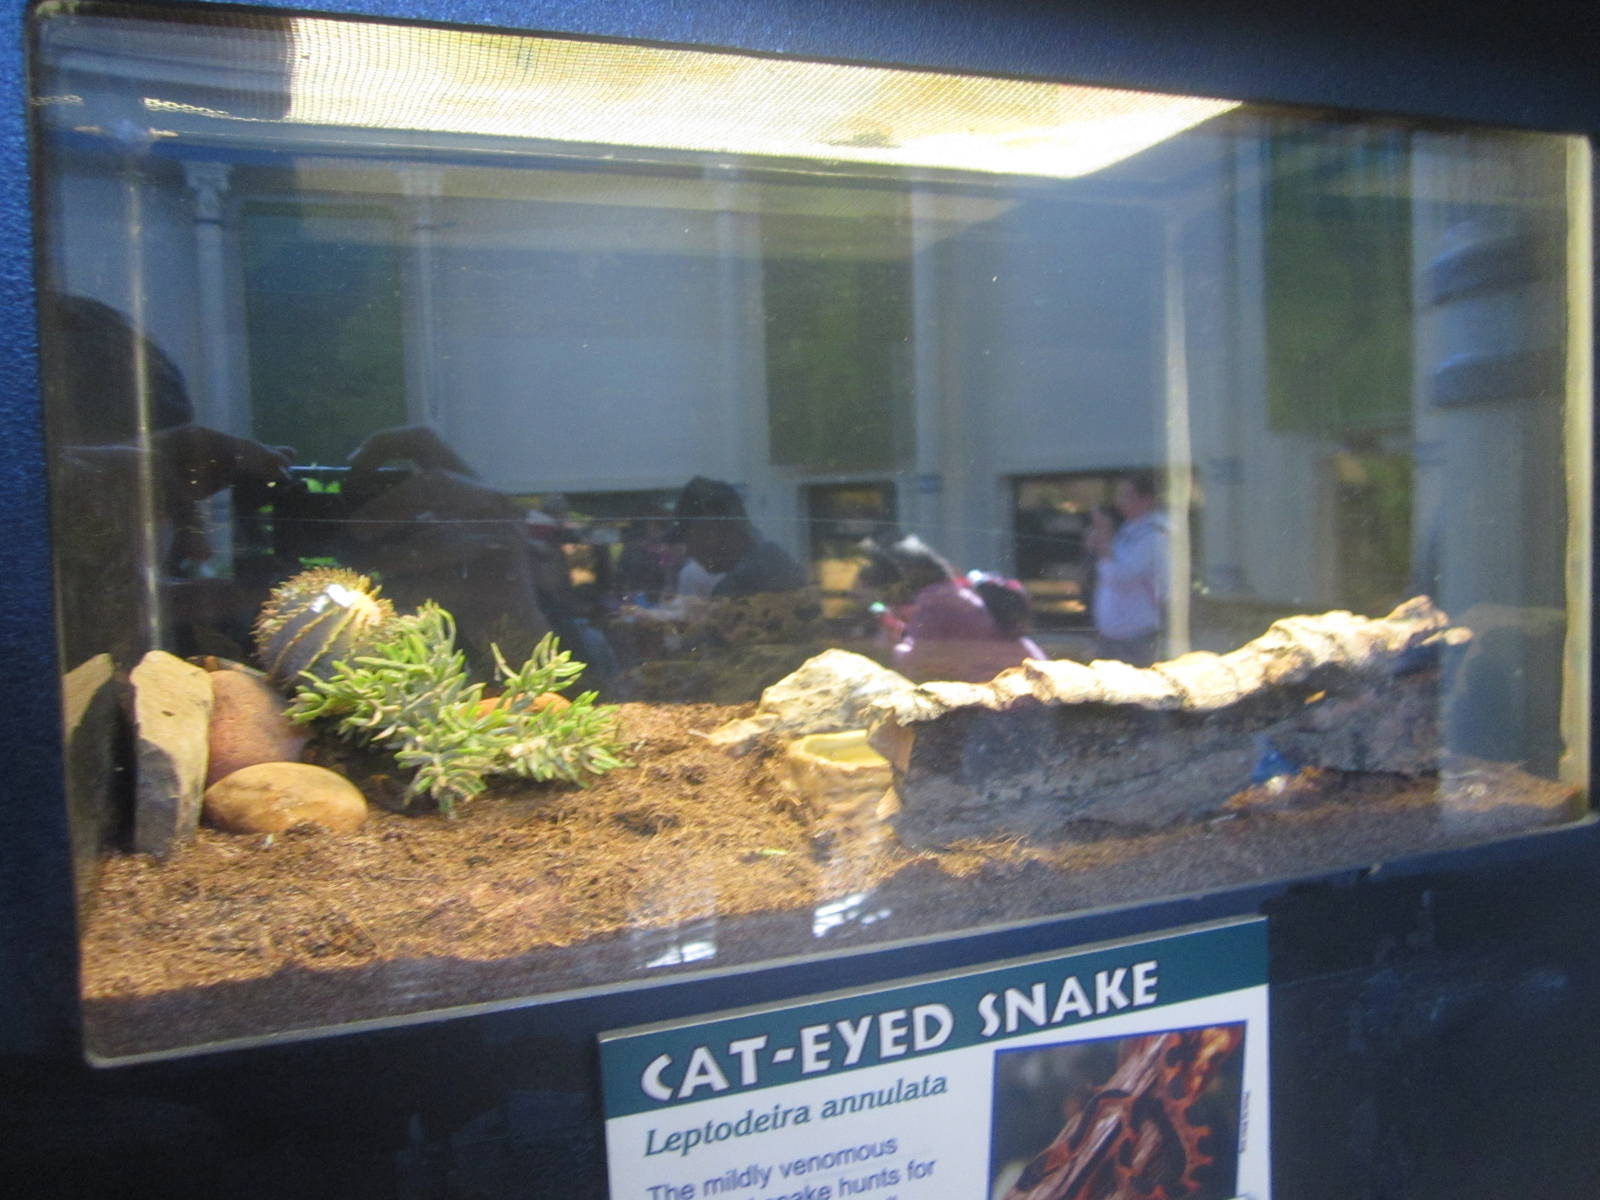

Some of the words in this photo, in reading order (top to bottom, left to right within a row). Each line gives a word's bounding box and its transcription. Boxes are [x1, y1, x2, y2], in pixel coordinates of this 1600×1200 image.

[641, 1003, 954, 1101] CAT-EYED
[977, 959, 1158, 1037] SNAKE
[644, 1101, 811, 1156] Leptodeira
[820, 1074, 948, 1119] annulata
[646, 1183, 695, 1200] The
[703, 1163, 773, 1196] mildly
[779, 1137, 898, 1179] venomous
[838, 1167, 900, 1197] hunts
[907, 1159, 937, 1181] for
